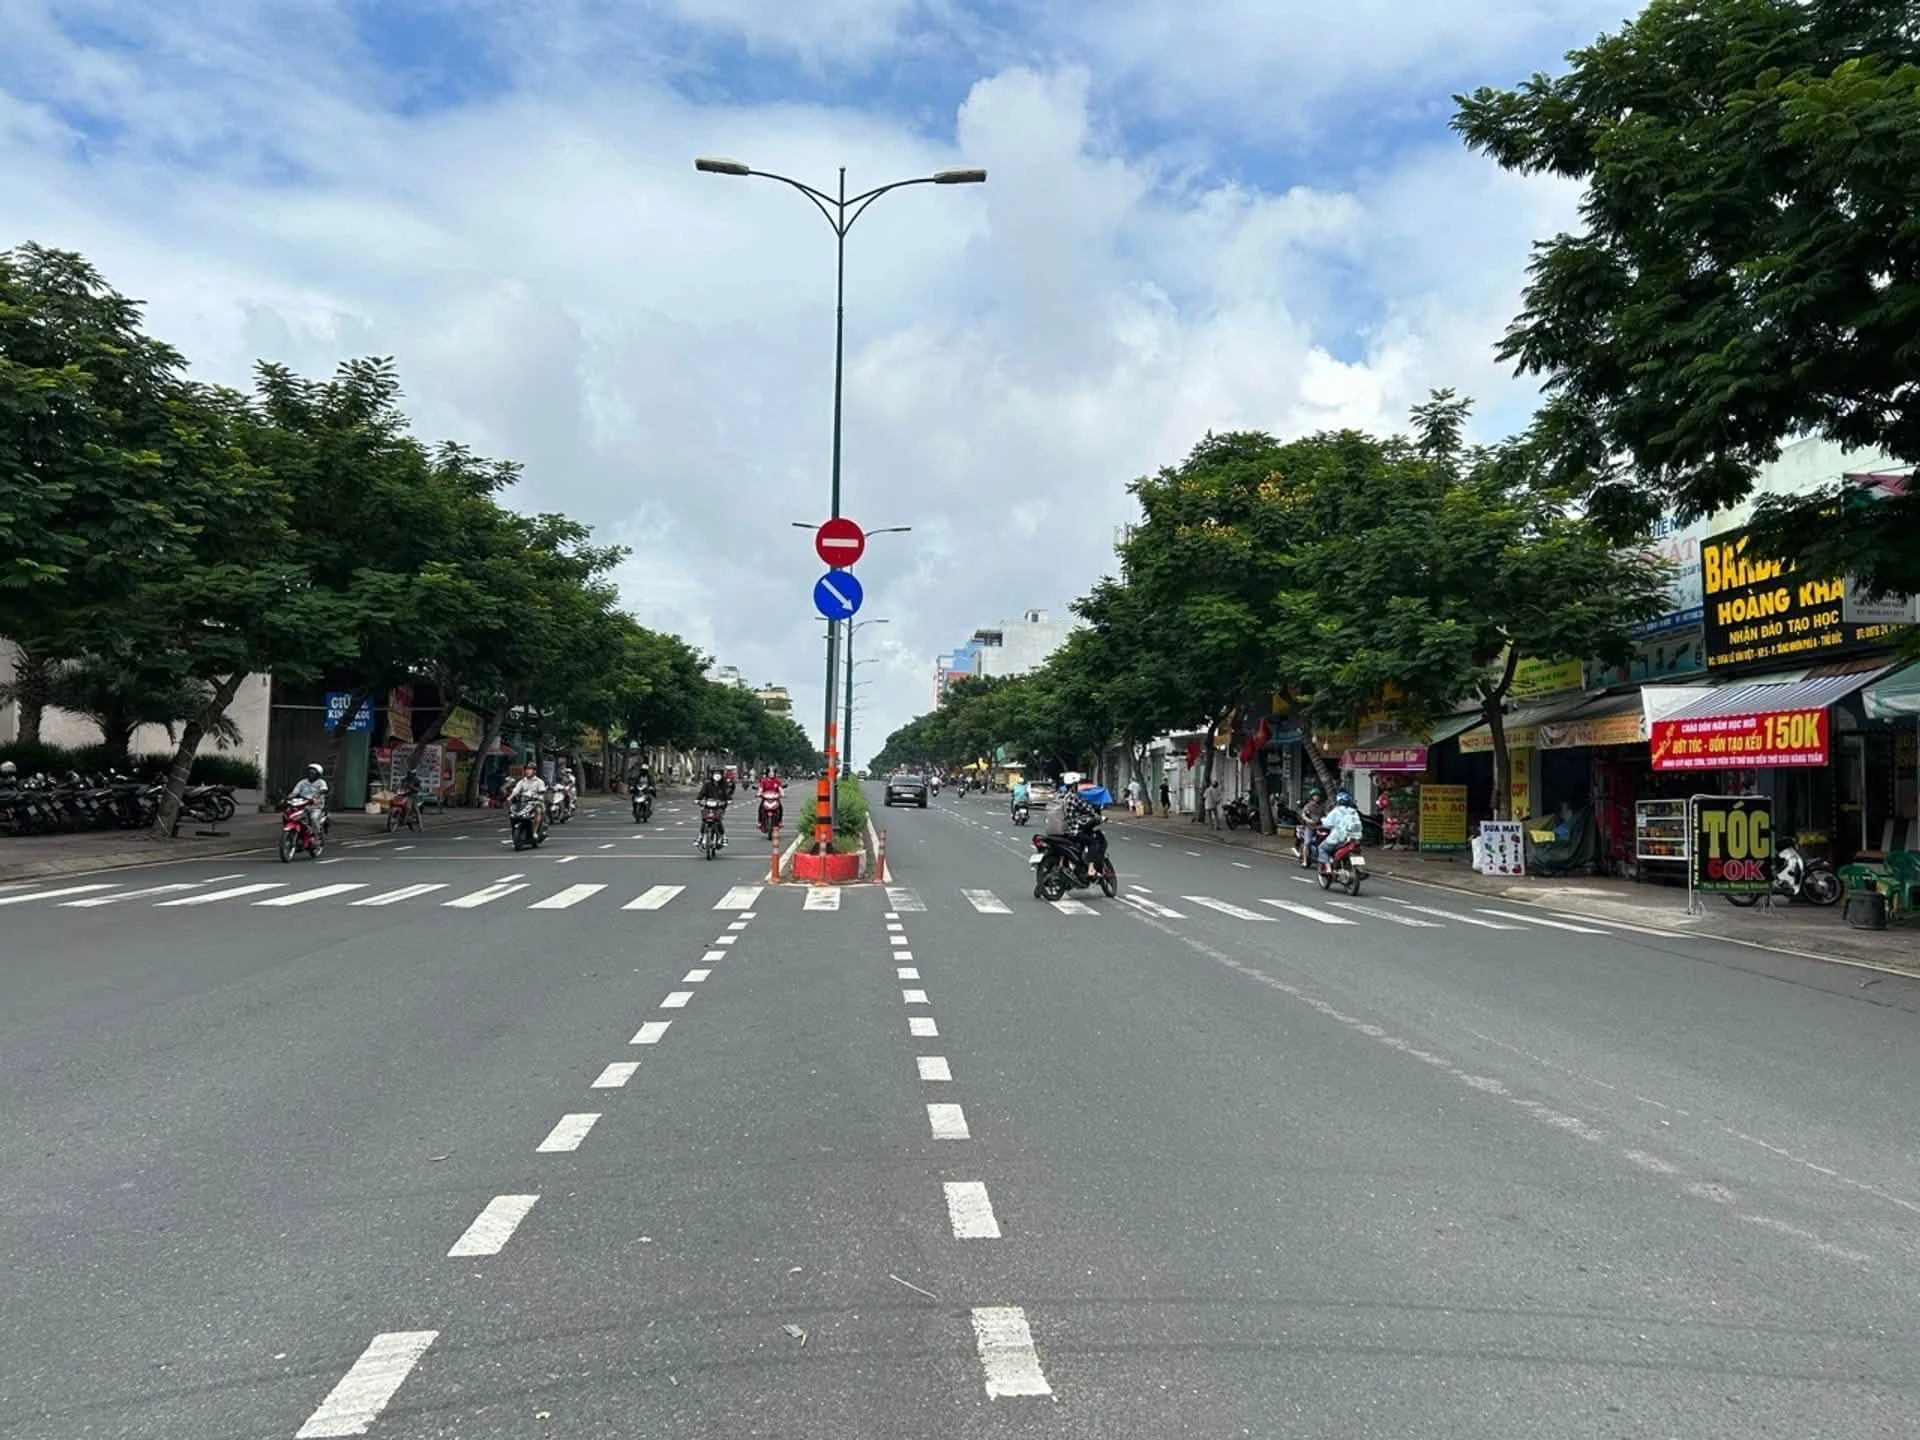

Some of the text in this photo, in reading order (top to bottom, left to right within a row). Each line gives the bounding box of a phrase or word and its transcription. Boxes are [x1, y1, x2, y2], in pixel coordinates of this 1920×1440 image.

[1717, 587, 1791, 626] HOÀNG
[1788, 616, 1810, 636] TẠO
[1813, 610, 1840, 630] HỌC
[1727, 733, 1743, 755] TẠO
[1765, 713, 1821, 750] 150K
[1702, 801, 1769, 859] TÓC
